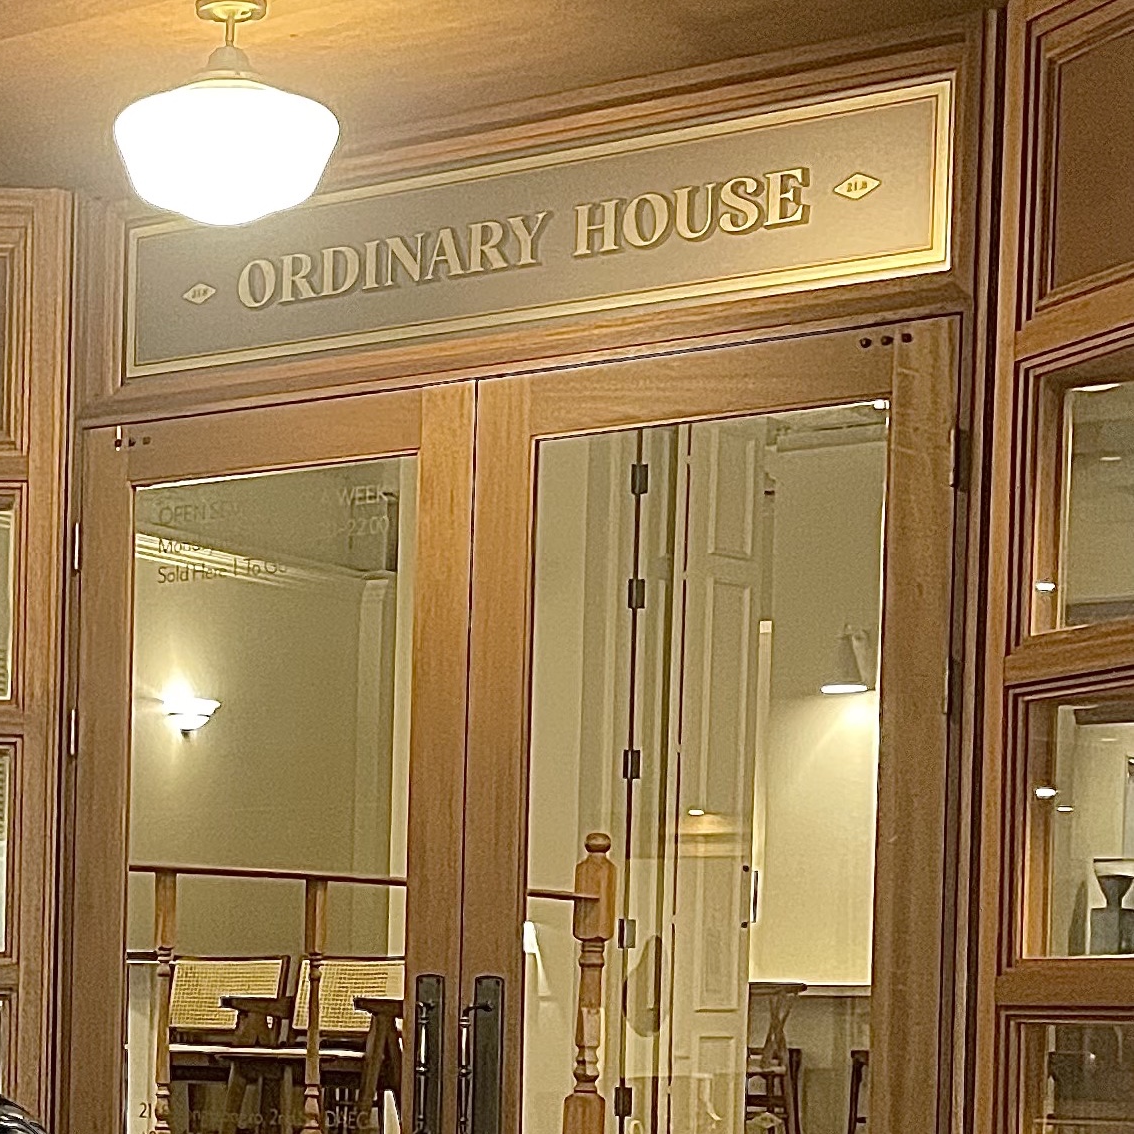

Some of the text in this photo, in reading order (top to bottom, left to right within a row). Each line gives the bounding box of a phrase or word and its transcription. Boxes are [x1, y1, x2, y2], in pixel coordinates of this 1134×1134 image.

[237, 167, 811, 309] ORDINARY HOUSE
[338, 485, 388, 506] WEEK
[157, 565, 189, 584] Sold
